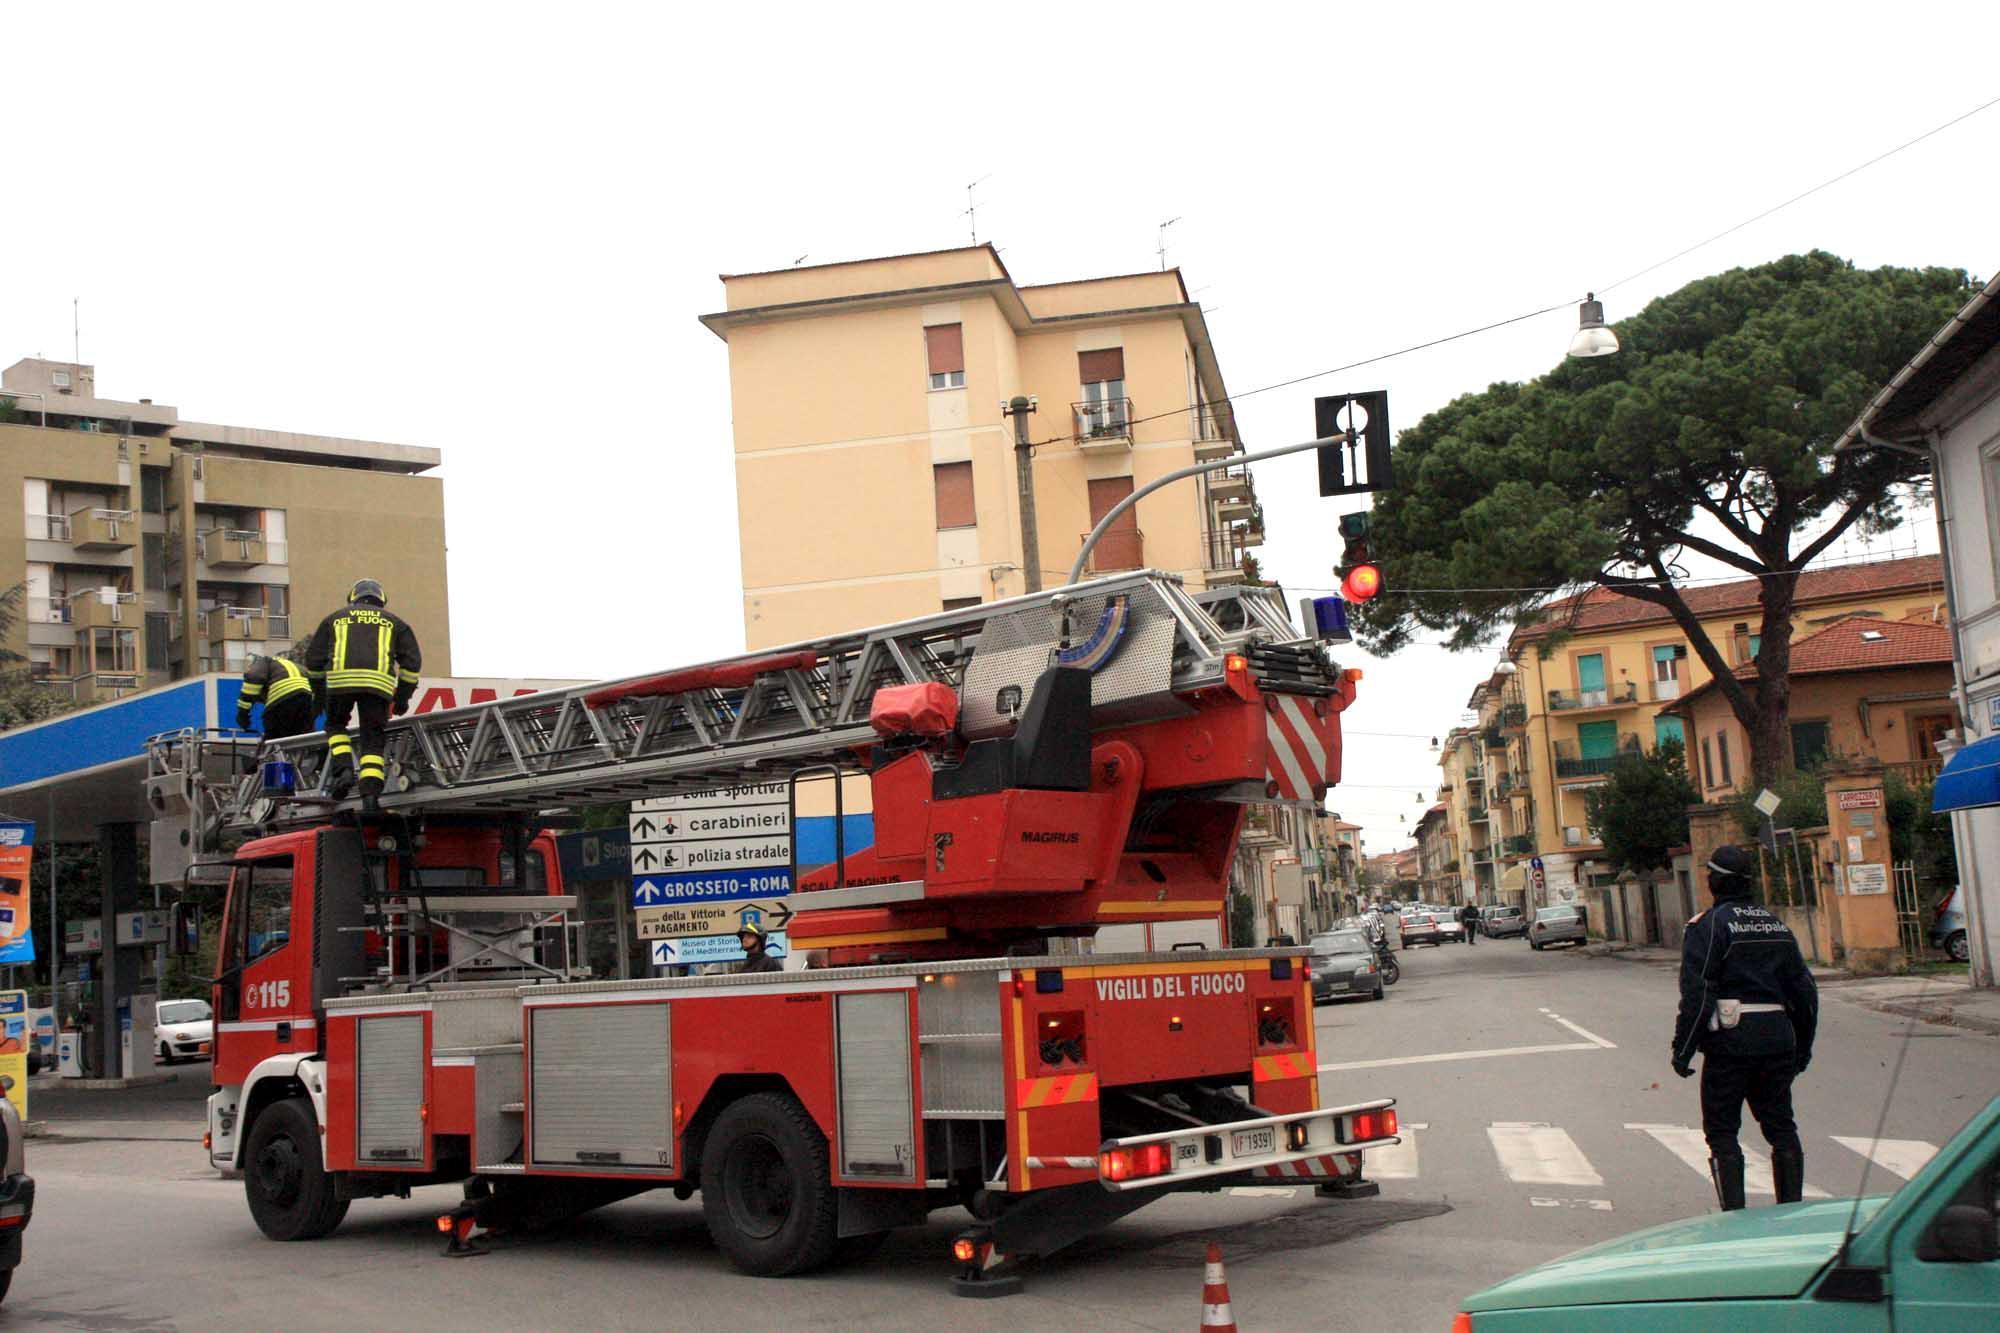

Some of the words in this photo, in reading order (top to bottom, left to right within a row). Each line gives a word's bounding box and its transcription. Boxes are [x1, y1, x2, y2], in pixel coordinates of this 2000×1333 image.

[333, 617, 354, 627] DEL
[357, 616, 394, 630] FUOCO
[689, 812, 786, 831] carabinieri
[1022, 831, 1080, 844] MAGIRUS
[688, 848, 732, 867] polizia
[735, 844, 789, 860] stradale
[664, 875, 790, 898] GROSSETO-ROMA
[662, 911, 686, 922] della
[690, 908, 726, 920] Vittoria
[1732, 905, 1771, 917] Polizia
[642, 925, 649, 935] A
[655, 922, 709, 935] PAGAMENTO
[1728, 920, 1789, 934] Municipale
[681, 938, 706, 948] Museo
[708, 938, 716, 947] di
[1096, 978, 1147, 1000] VIGILI
[1153, 976, 1185, 998] DEL
[1191, 973, 1246, 996] FUOCO
[259, 980, 290, 1008] 115
